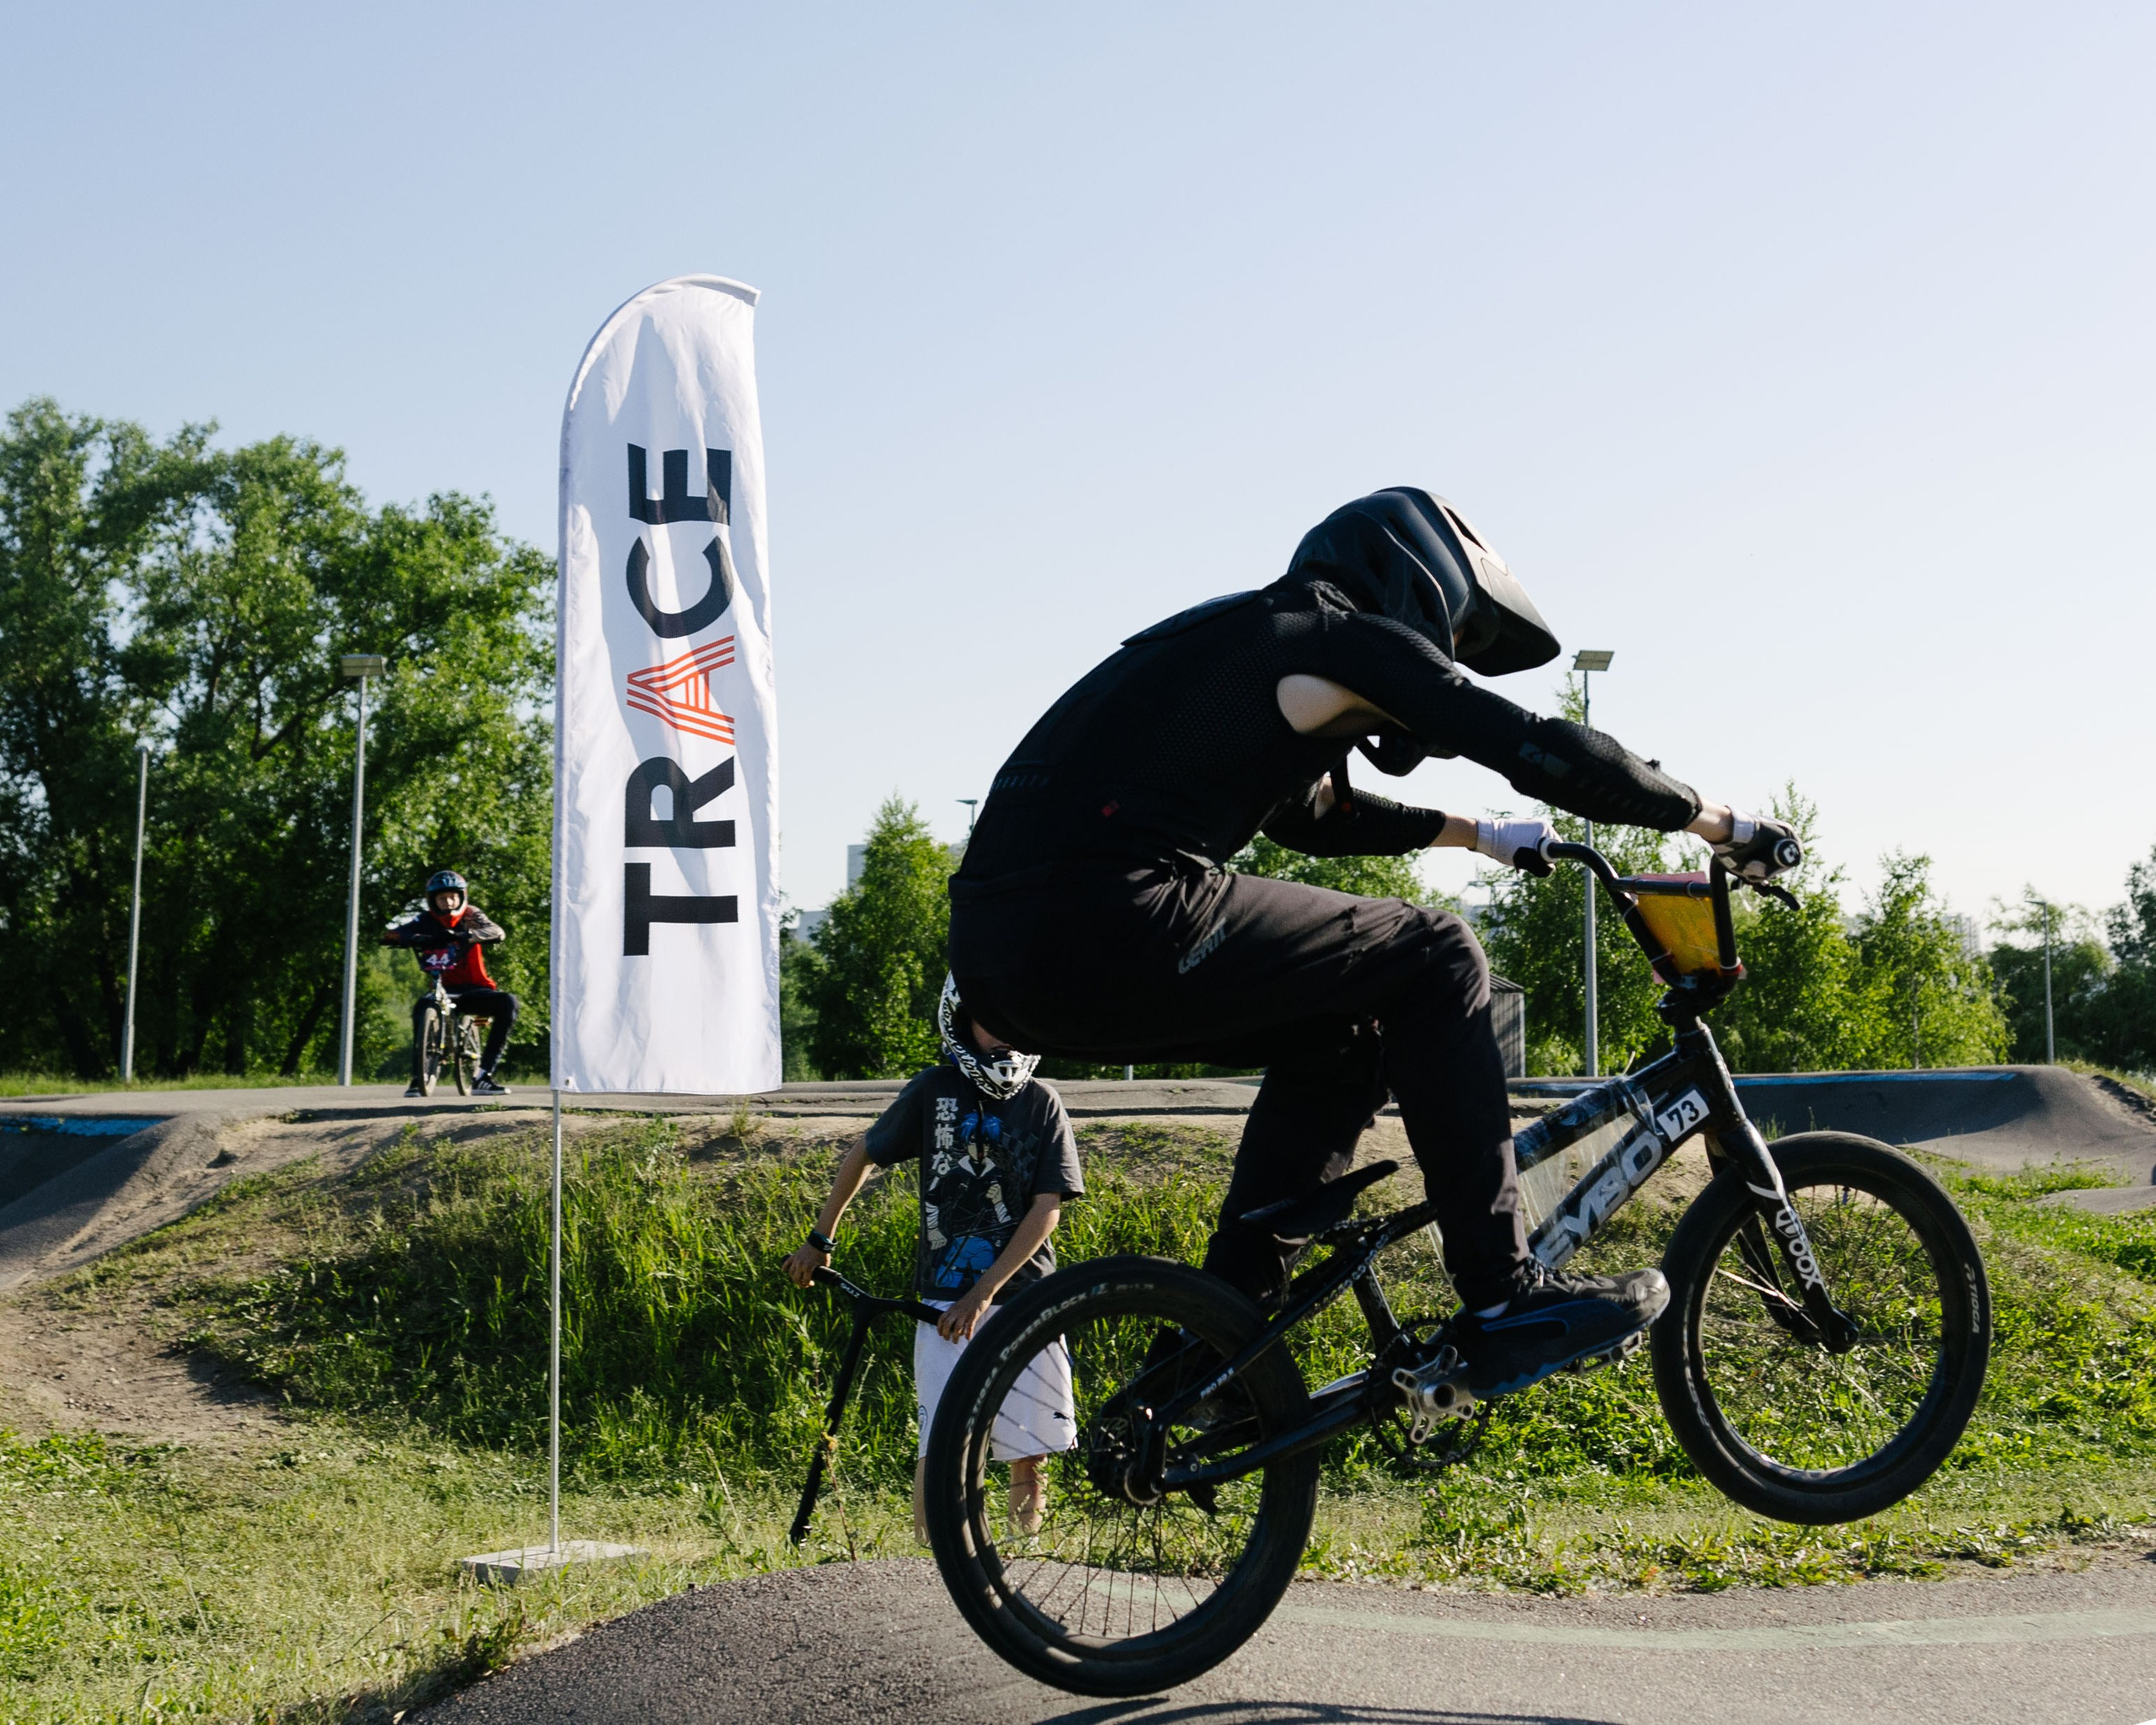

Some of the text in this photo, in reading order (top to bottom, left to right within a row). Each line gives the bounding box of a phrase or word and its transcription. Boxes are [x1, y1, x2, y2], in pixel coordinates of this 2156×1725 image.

[623, 442, 739, 957] TRACE
[425, 953, 451, 967] 44
[931, 1097, 959, 1176] 恐怖な
[1667, 1099, 1700, 1133] 73
[1967, 1283, 1981, 1334] TIOGA
